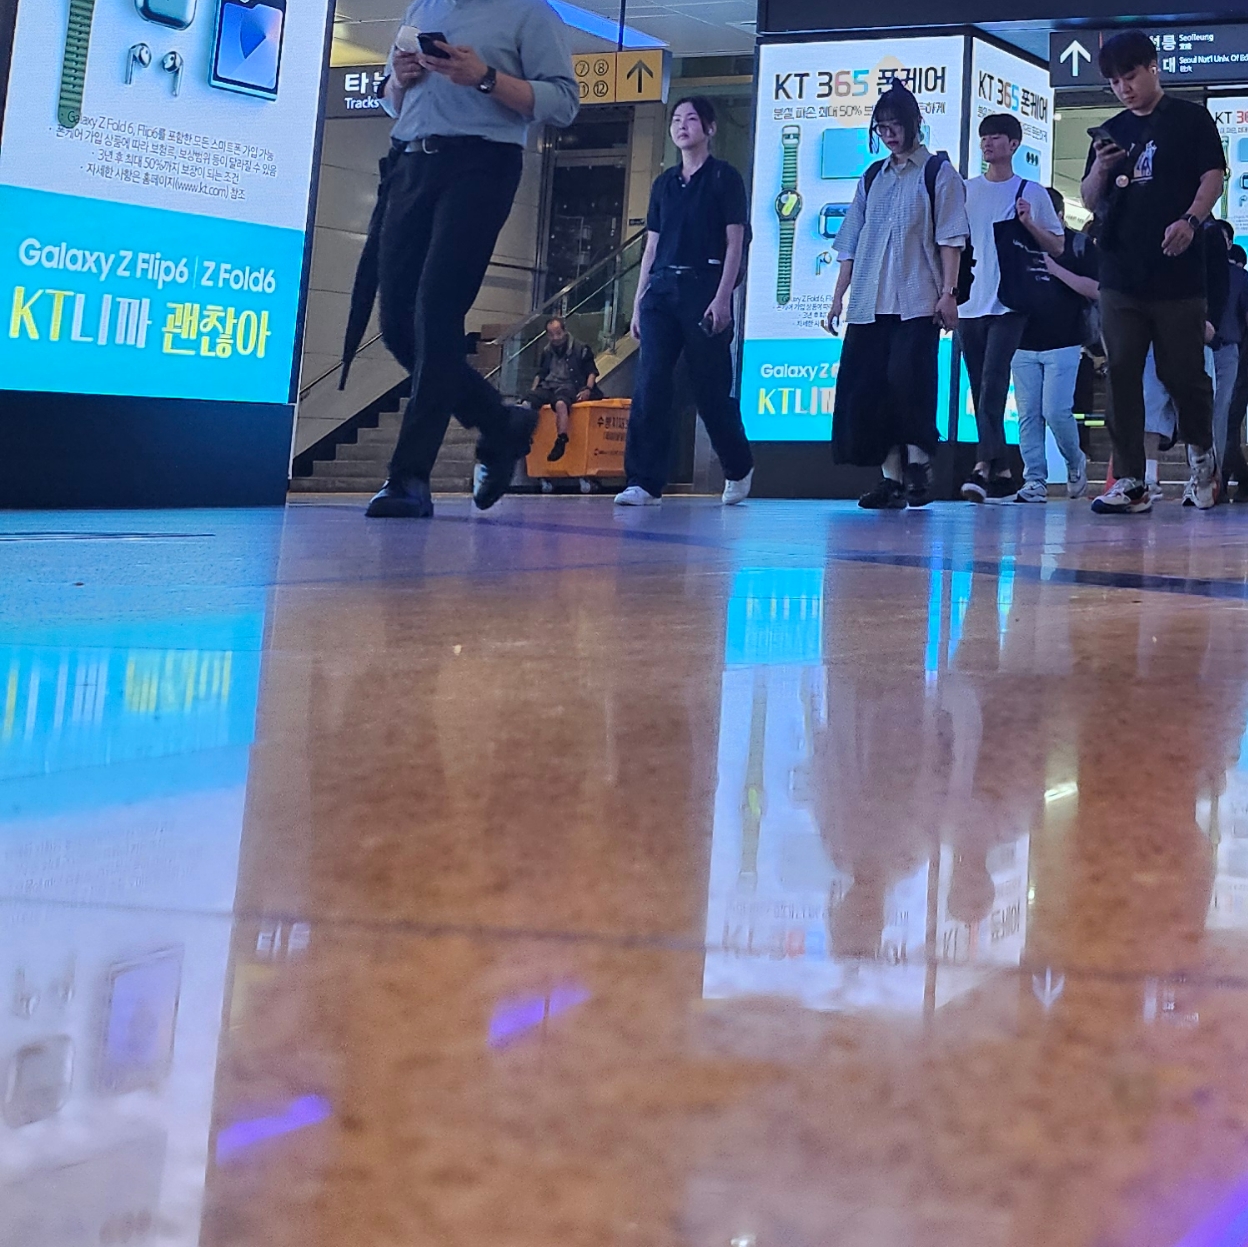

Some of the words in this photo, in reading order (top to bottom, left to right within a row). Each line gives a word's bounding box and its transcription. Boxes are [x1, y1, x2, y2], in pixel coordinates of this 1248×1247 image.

[774, 72, 810, 100] KT
[816, 69, 869, 99] 365
[979, 70, 994, 101] KT
[997, 78, 1019, 111] 365
[1021, 88, 1048, 123] 폰케어
[344, 96, 380, 109] Tracks
[840, 105, 862, 117] 50%
[1215, 111, 1233, 124] KT
[19, 238, 113, 281] Galaxy
[116, 246, 131, 274] Z
[136, 253, 189, 289] Flip6
[201, 261, 216, 286] Z
[219, 264, 276, 293] Fold6
[162, 301, 271, 358] 괜찮아
[760, 363, 818, 381] Galaxy
[819, 363, 829, 378] Z
